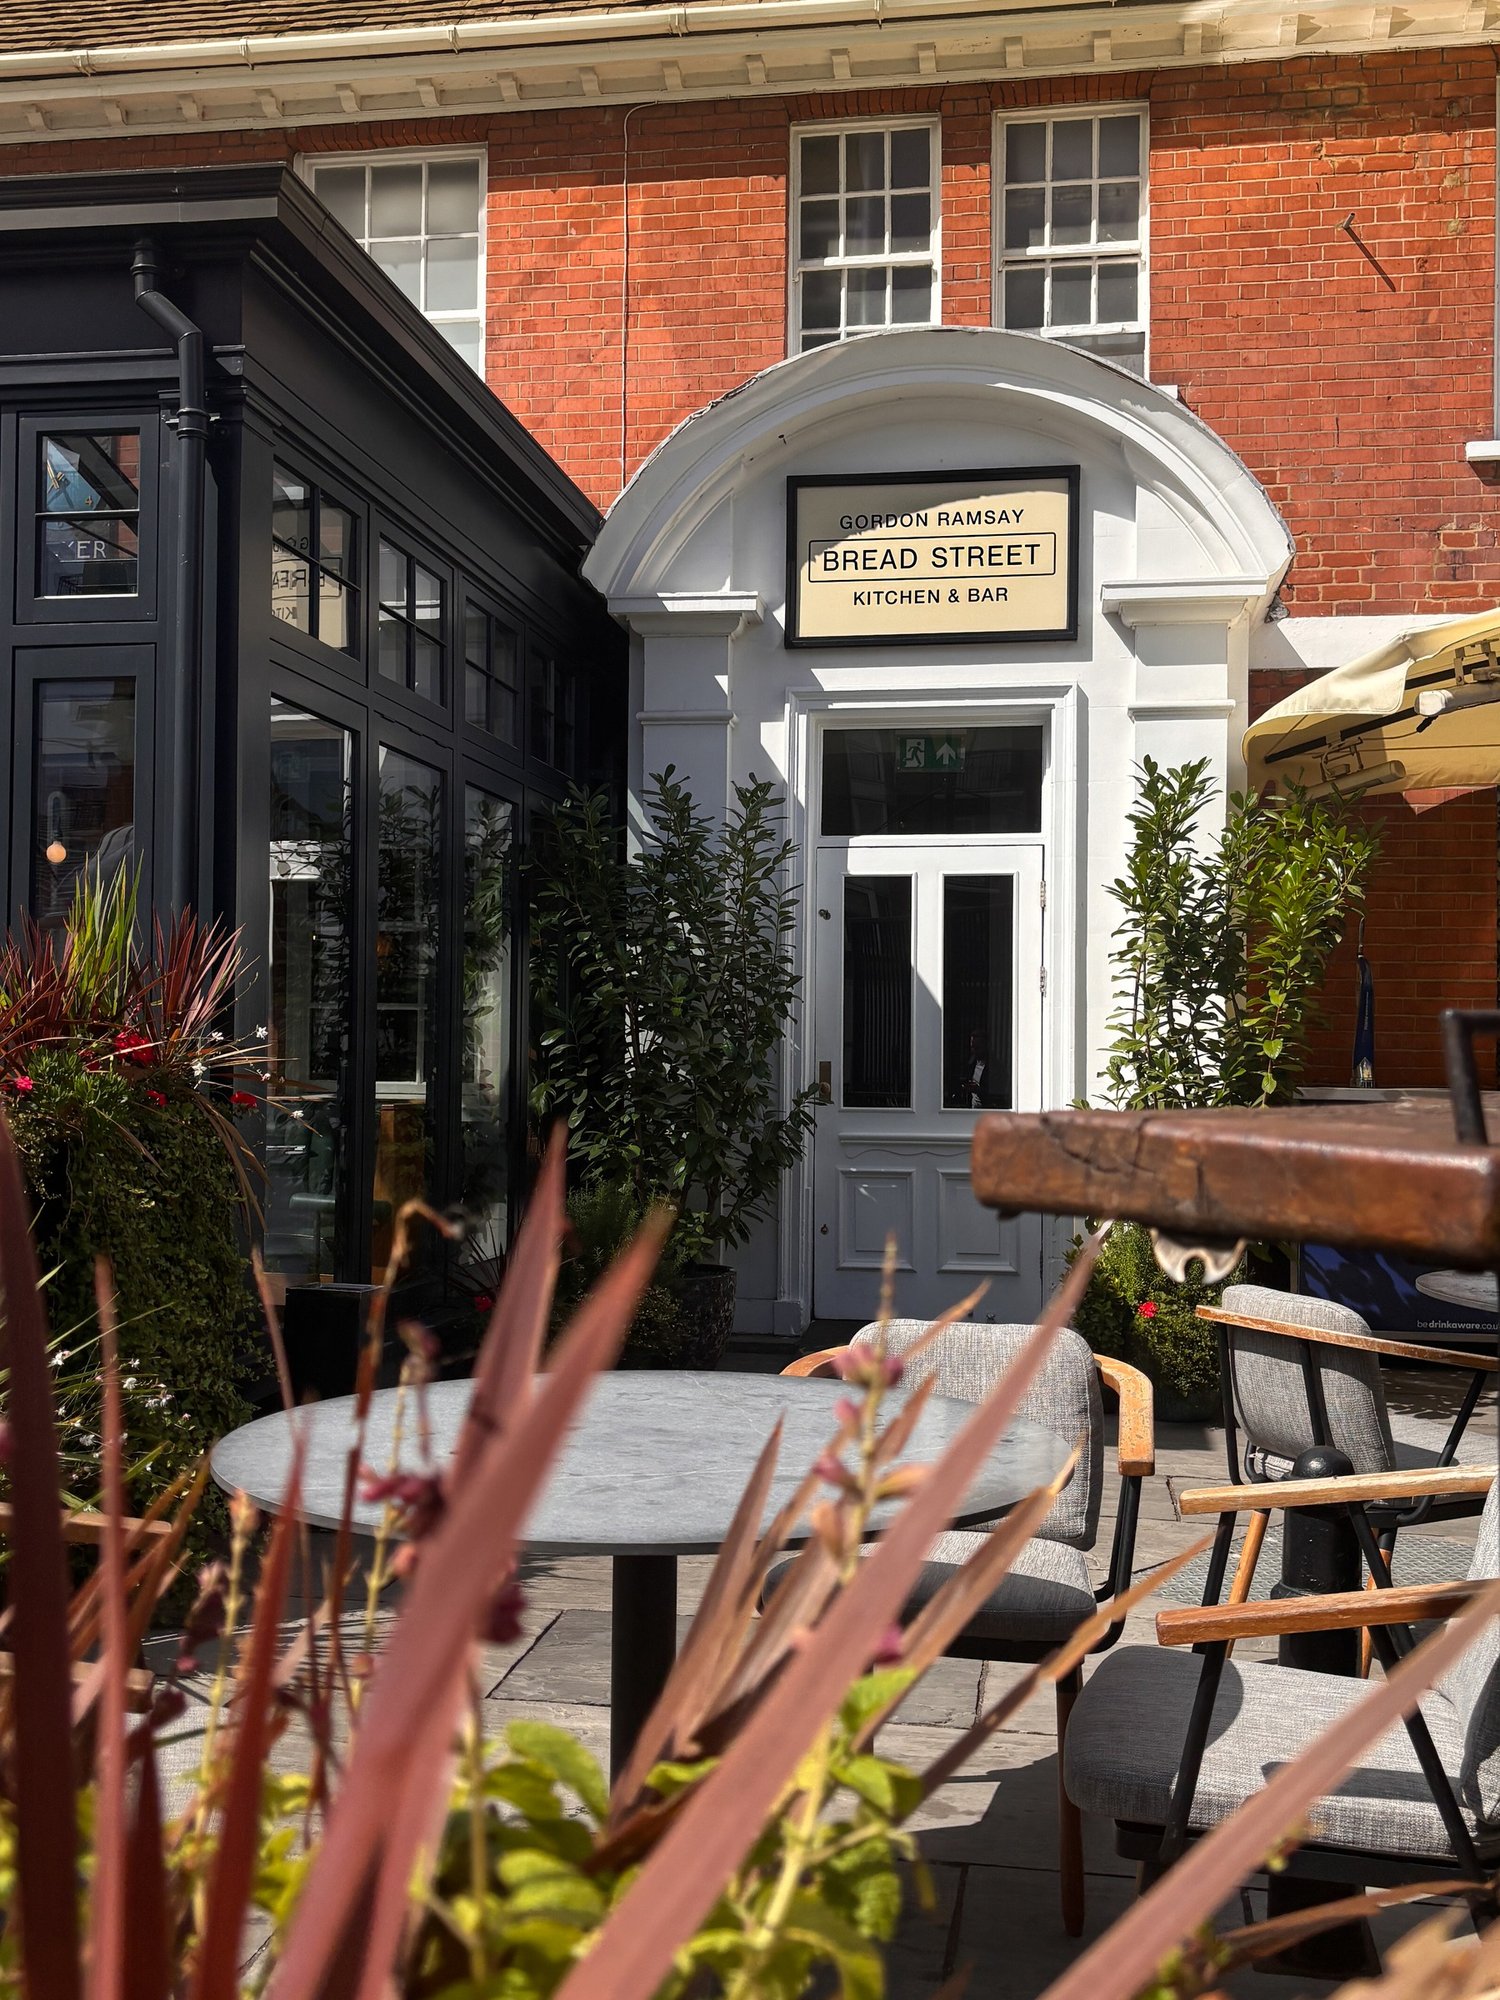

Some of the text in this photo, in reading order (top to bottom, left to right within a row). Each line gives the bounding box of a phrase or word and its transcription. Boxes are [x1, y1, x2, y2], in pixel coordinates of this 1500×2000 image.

[839, 509, 1025, 530] GORDON RAMSAY
[67, 540, 107, 559] ER
[823, 543, 1041, 572] BREAD STREET
[853, 587, 1009, 606] KITCHEN & BAR
[1416, 1319, 1500, 1331] bedrinkaware.co.u
